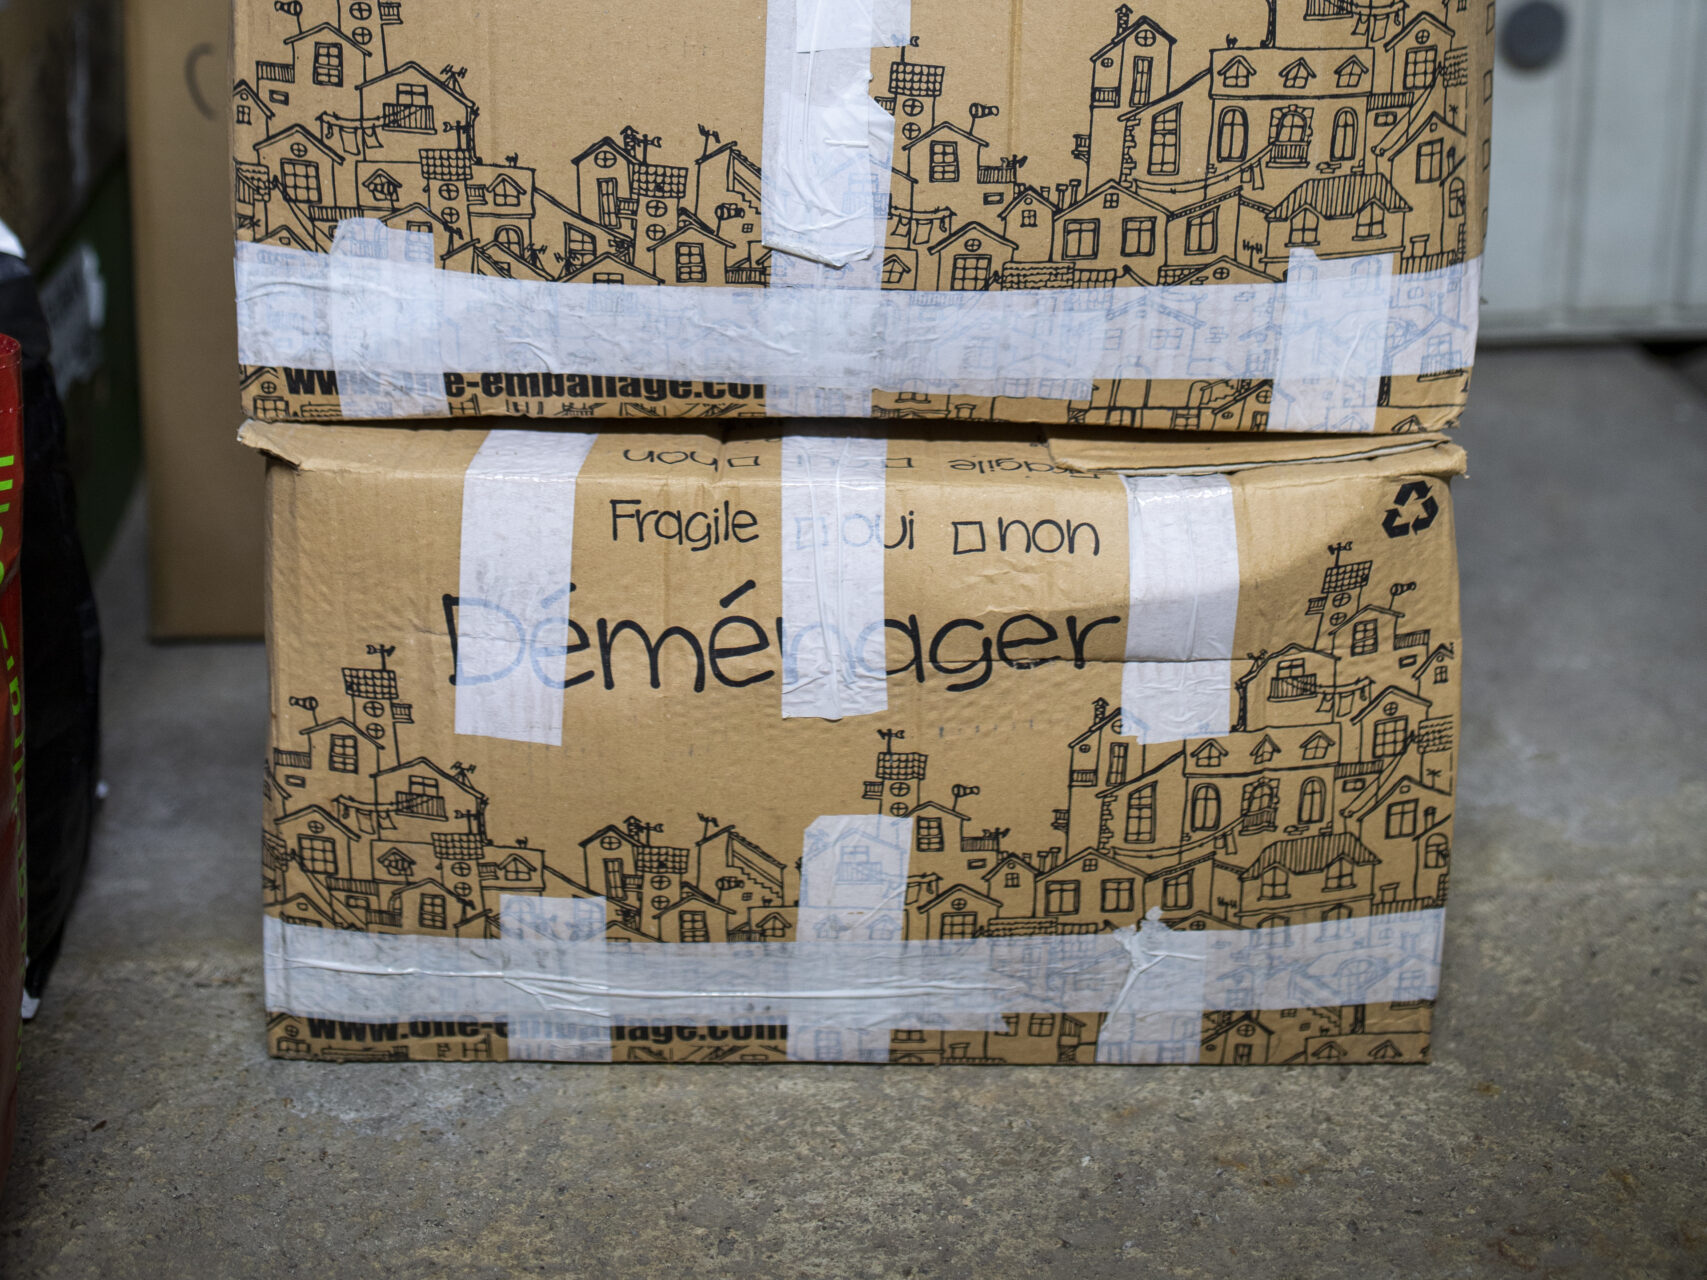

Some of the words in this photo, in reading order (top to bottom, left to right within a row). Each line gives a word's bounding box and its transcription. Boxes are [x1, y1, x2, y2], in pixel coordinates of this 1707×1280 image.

[609, 499, 759, 552] Fragile
[998, 517, 1100, 556] non
[442, 580, 1121, 692] Déménager
